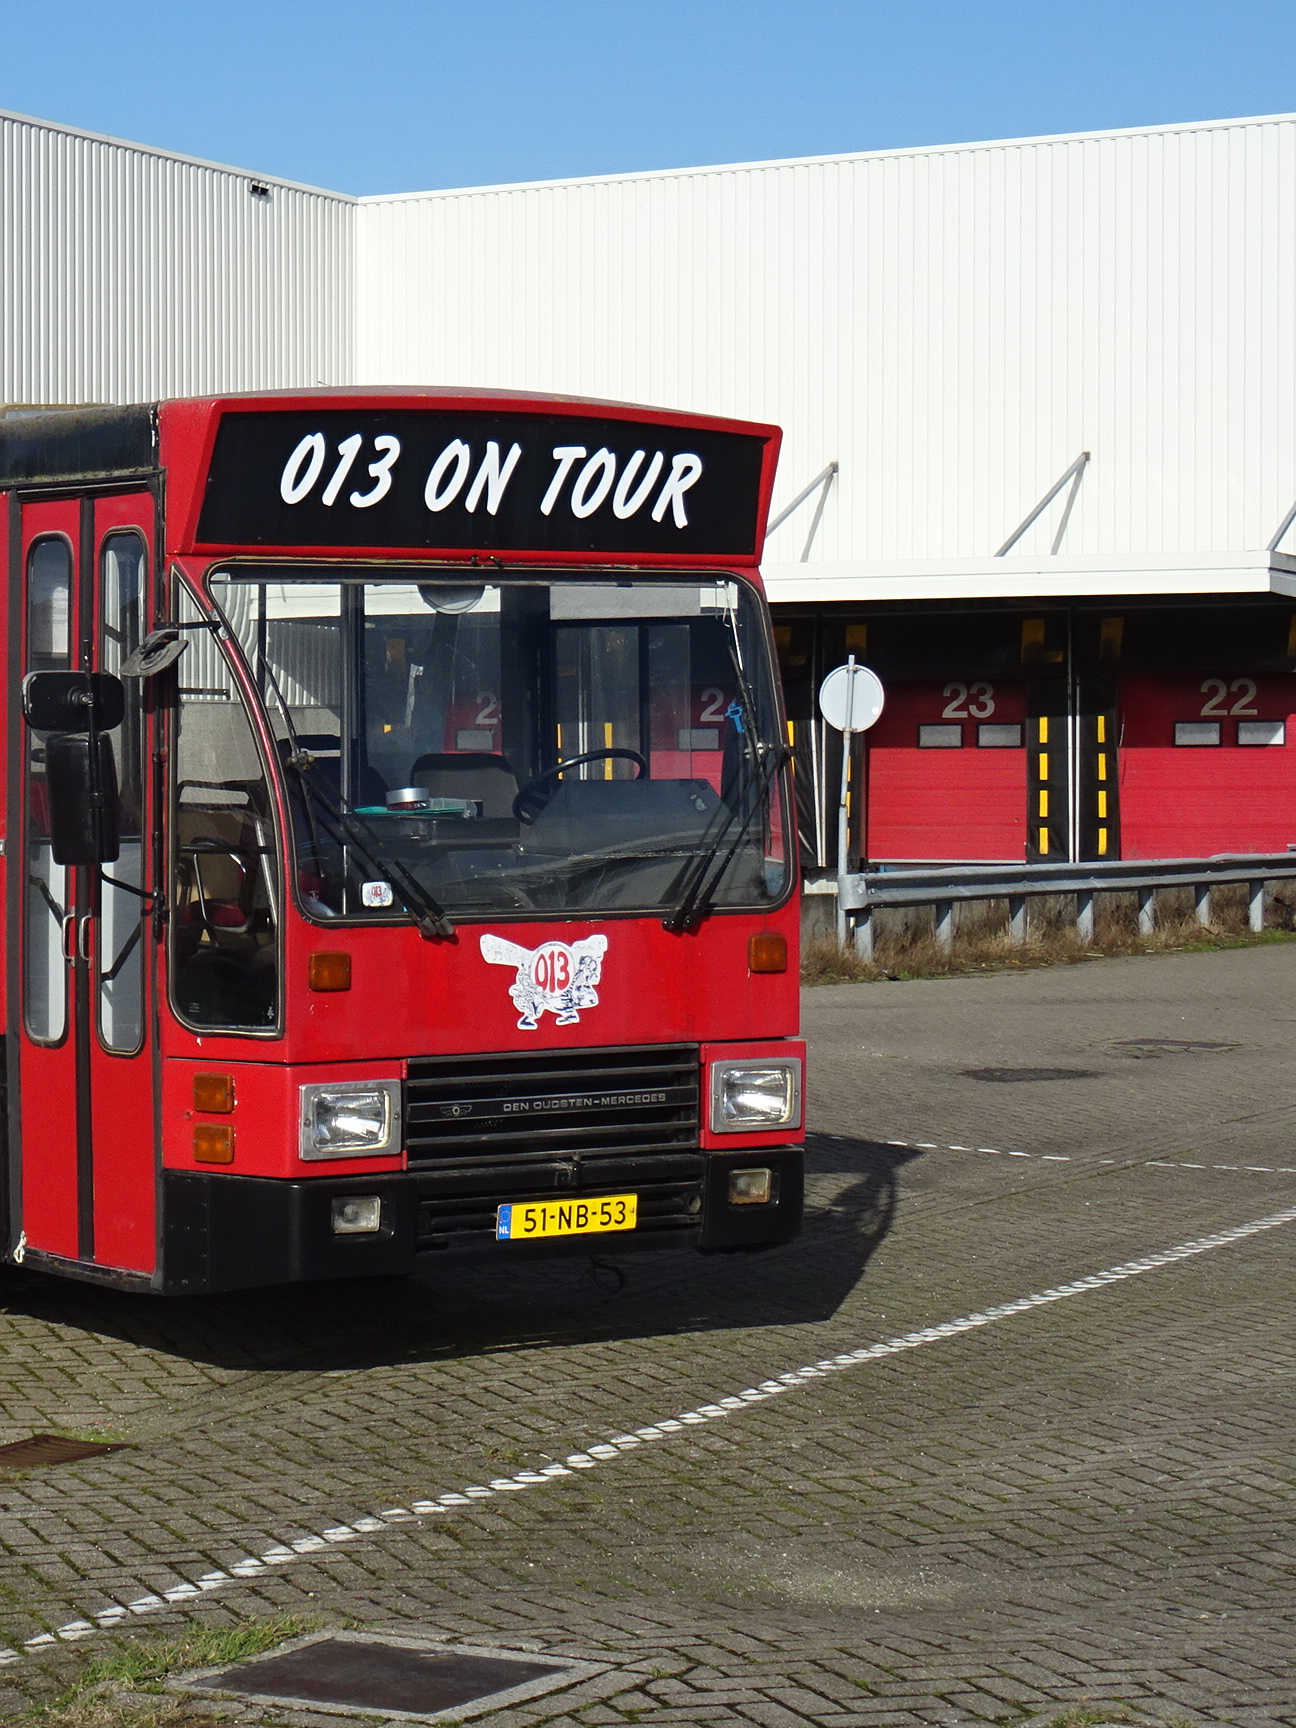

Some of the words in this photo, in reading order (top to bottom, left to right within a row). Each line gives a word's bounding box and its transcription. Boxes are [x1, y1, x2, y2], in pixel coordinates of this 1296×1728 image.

[281, 432, 401, 508] 013
[424, 438, 522, 516] ON
[540, 446, 702, 529] TOUR
[475, 691, 502, 724] 2
[942, 681, 995, 718] 23
[1199, 678, 1258, 716] 22
[535, 950, 570, 993] 013
[504, 1102, 529, 1112] DEN
[533, 1093, 666, 1110] OUDSTEN-MERCEDES
[498, 1225, 510, 1234] NL
[524, 1201, 626, 1233] 51-NB-53
